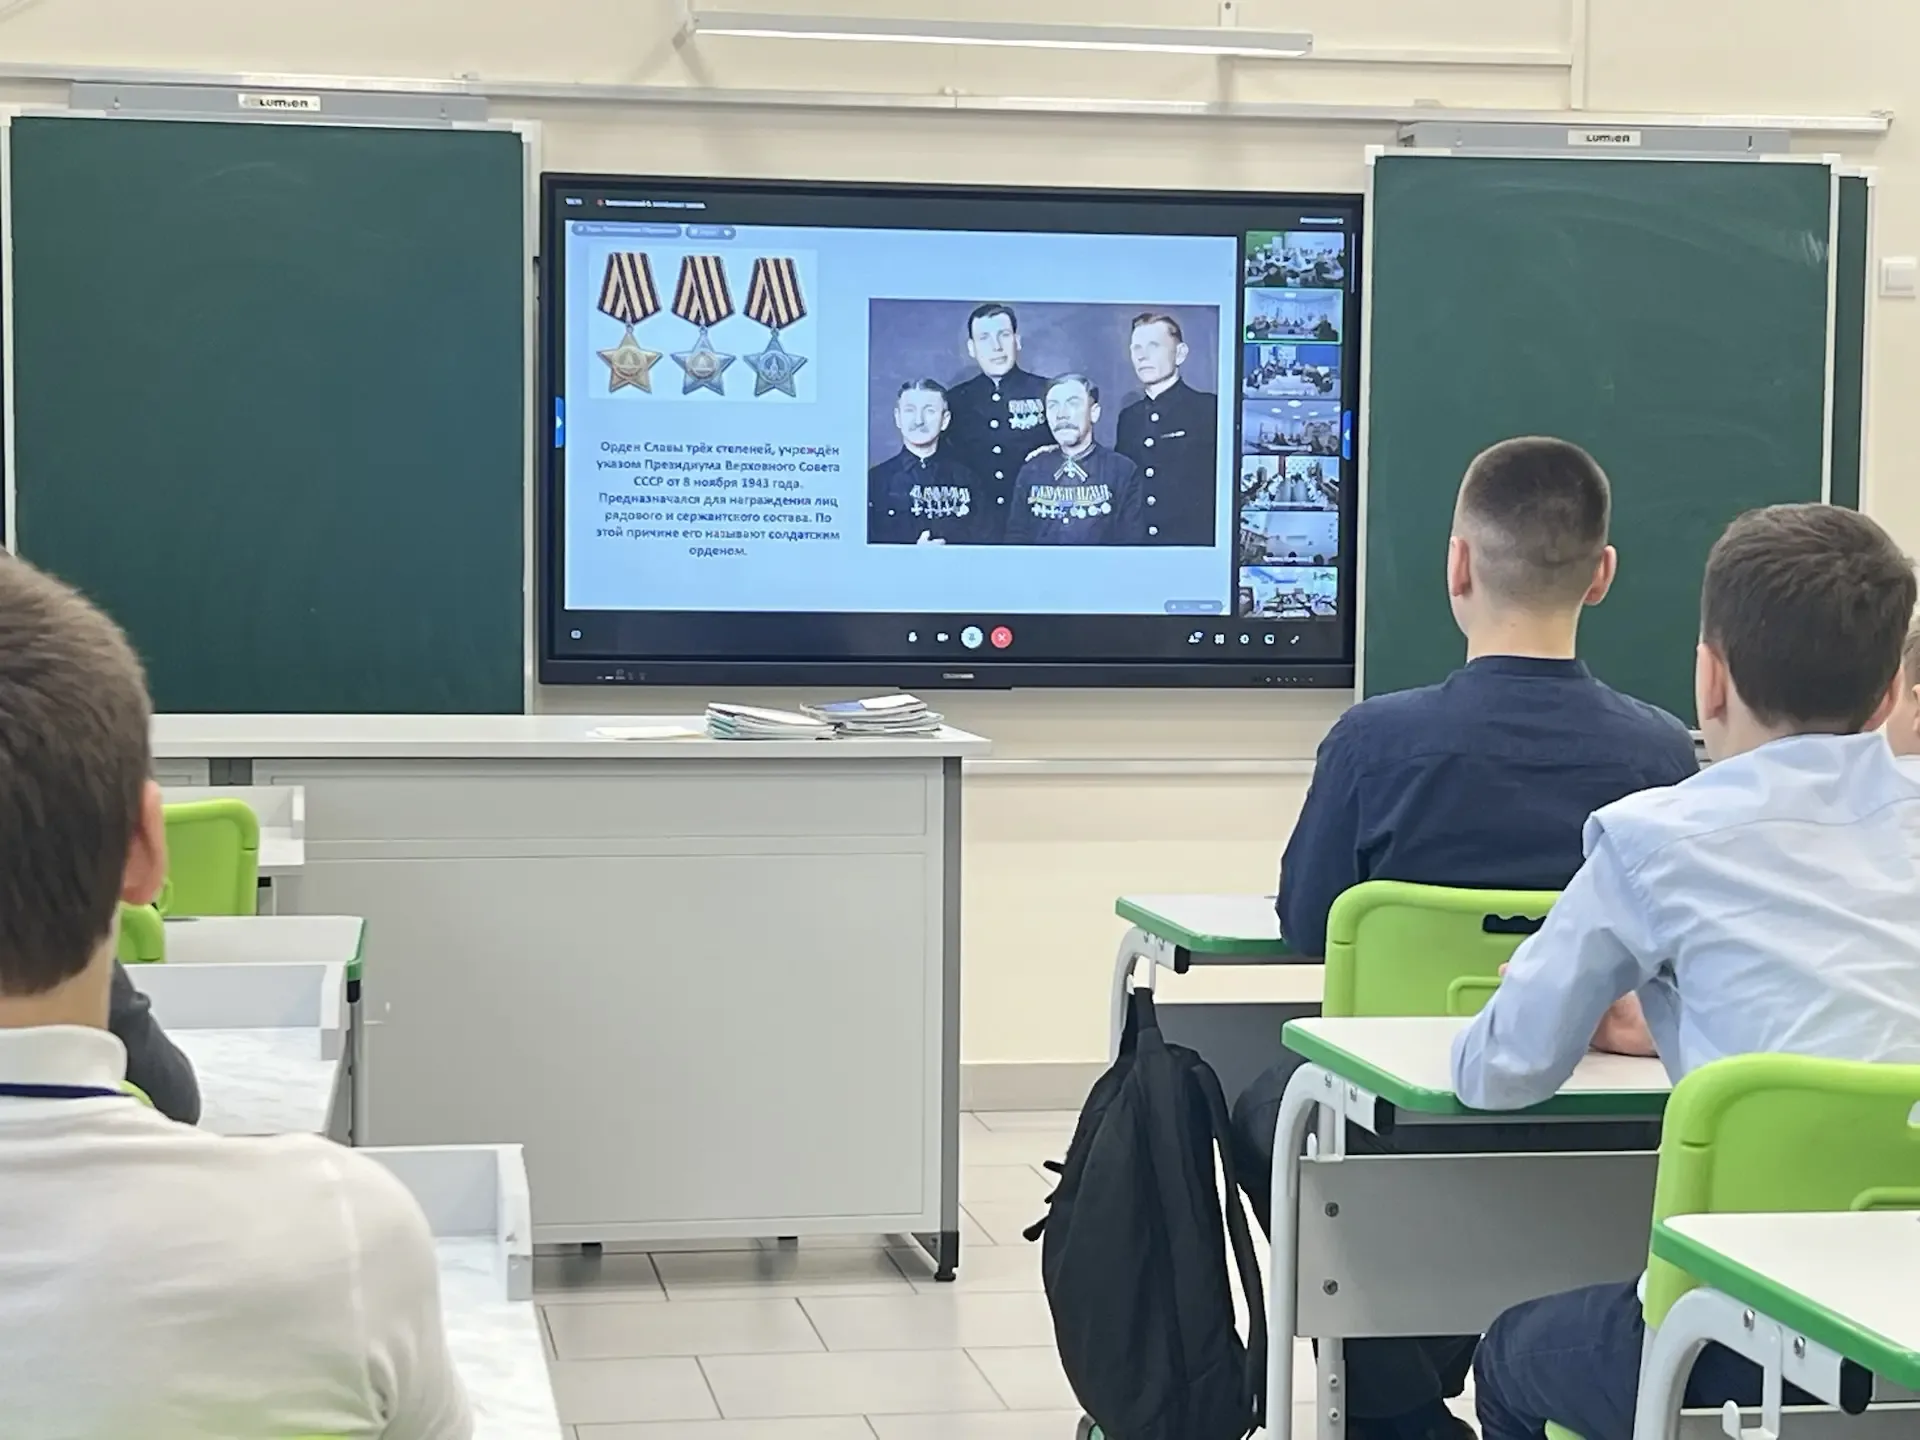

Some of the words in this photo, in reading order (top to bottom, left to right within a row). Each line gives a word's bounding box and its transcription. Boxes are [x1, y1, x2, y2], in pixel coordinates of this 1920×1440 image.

[601, 441, 640, 454] Орден
[799, 462, 840, 472] Совета
[633, 476, 663, 486] СССР
[667, 478, 680, 487] от
[683, 477, 690, 487] 8
[693, 477, 738, 490] ноября
[742, 478, 769, 488] 1943
[599, 492, 700, 505] Предназначался
[703, 496, 726, 507] для
[815, 498, 838, 508] лиц
[666, 512, 673, 521] и
[815, 513, 832, 523] По
[682, 530, 702, 538] его
